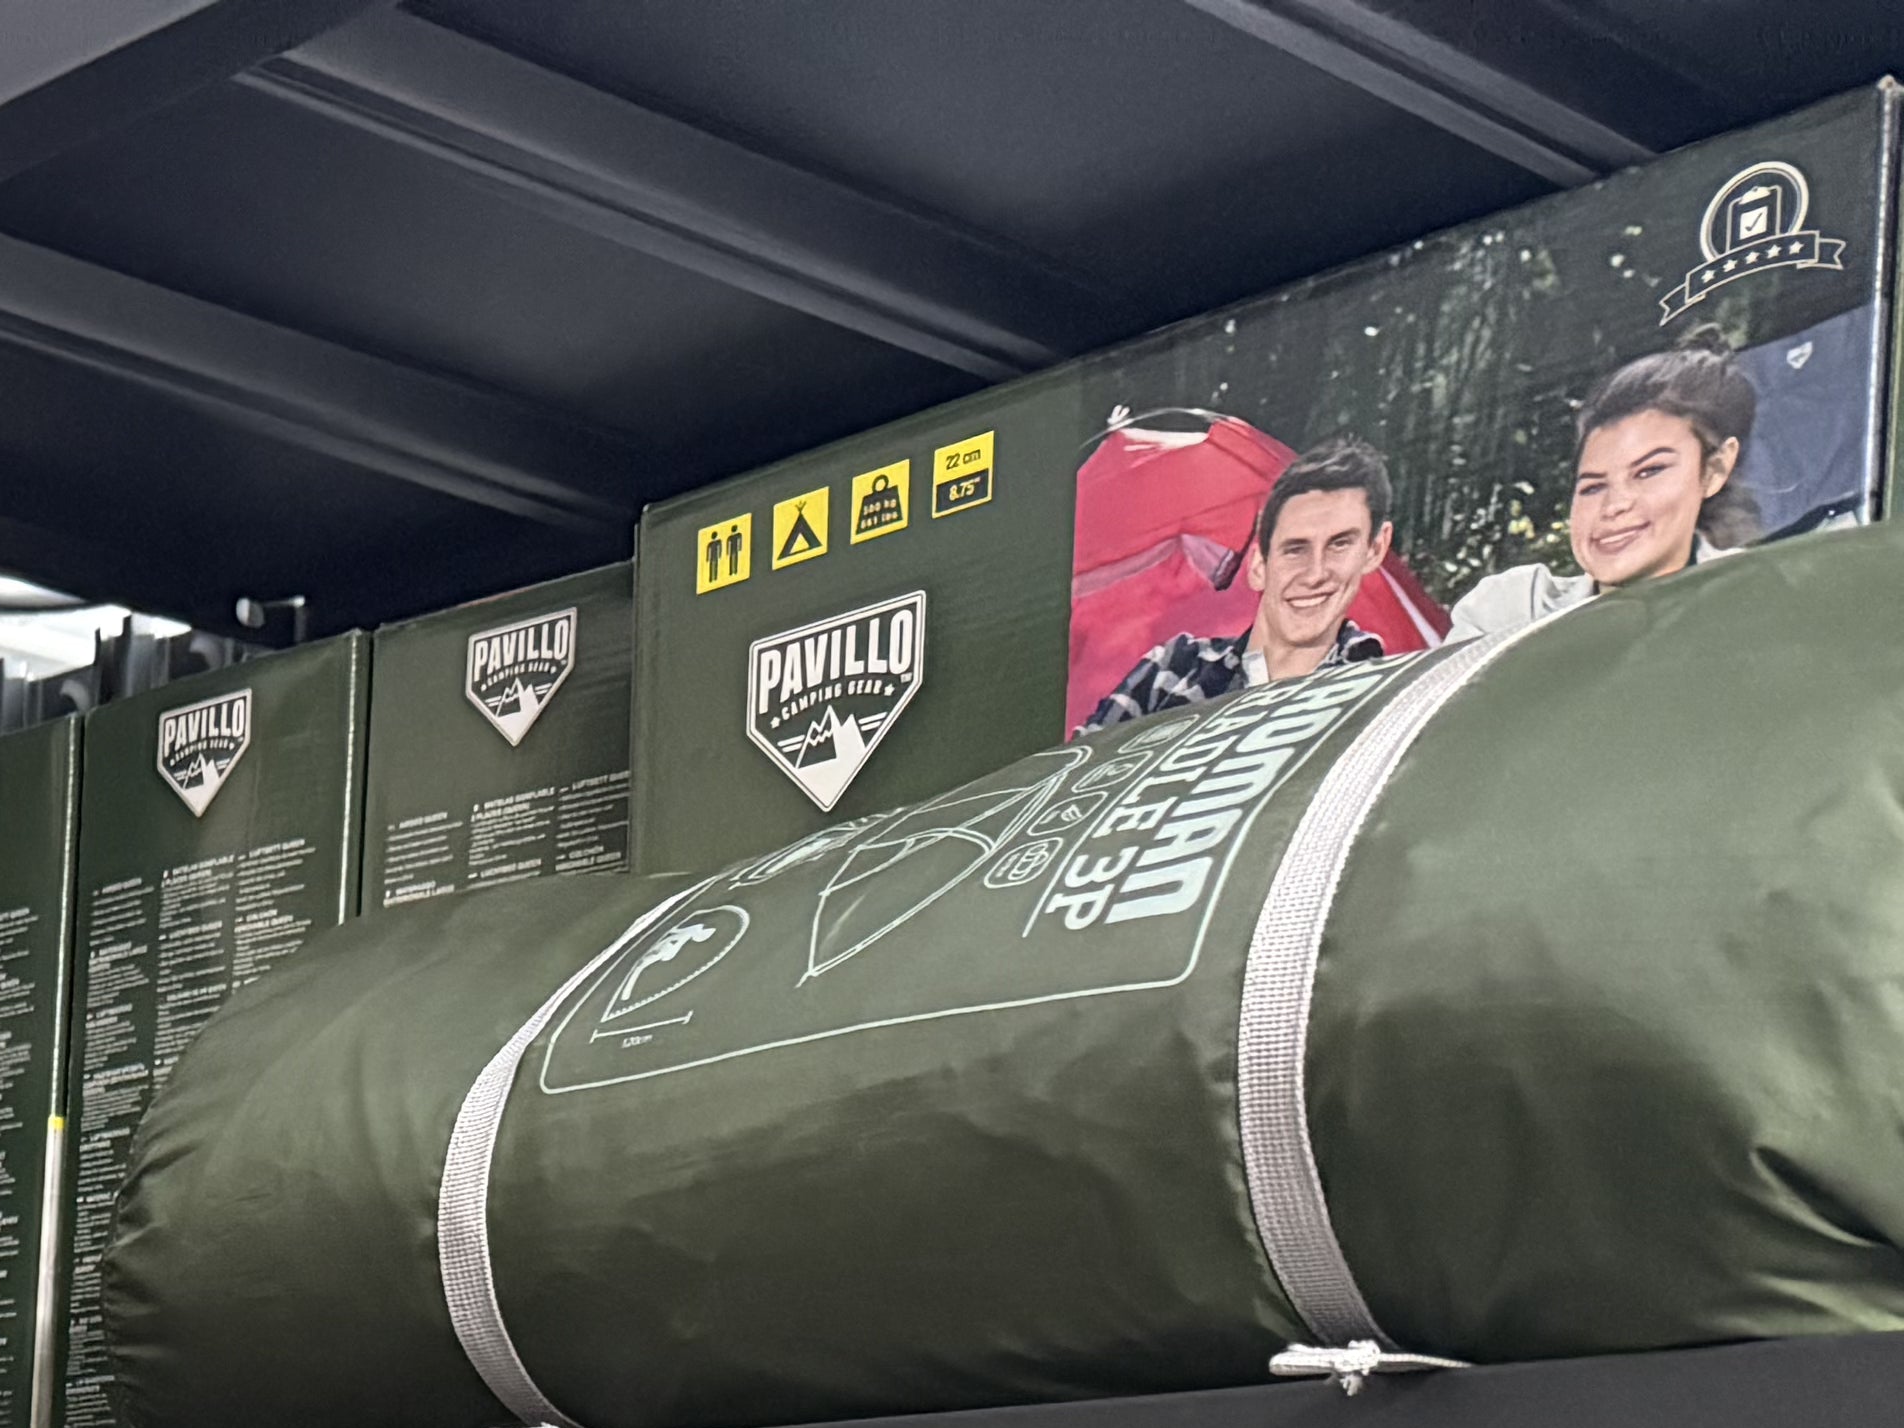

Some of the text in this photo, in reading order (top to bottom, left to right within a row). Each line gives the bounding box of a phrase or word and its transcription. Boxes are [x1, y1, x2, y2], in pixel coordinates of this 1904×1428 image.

[946, 449, 981, 470] 22 cm
[473, 619, 570, 678] PAVILLO
[759, 609, 913, 714] PAVILLO
[781, 679, 882, 721] CAMPING GEAR
[162, 704, 246, 755] PAVILLO
[1046, 846, 1138, 931] 3P
